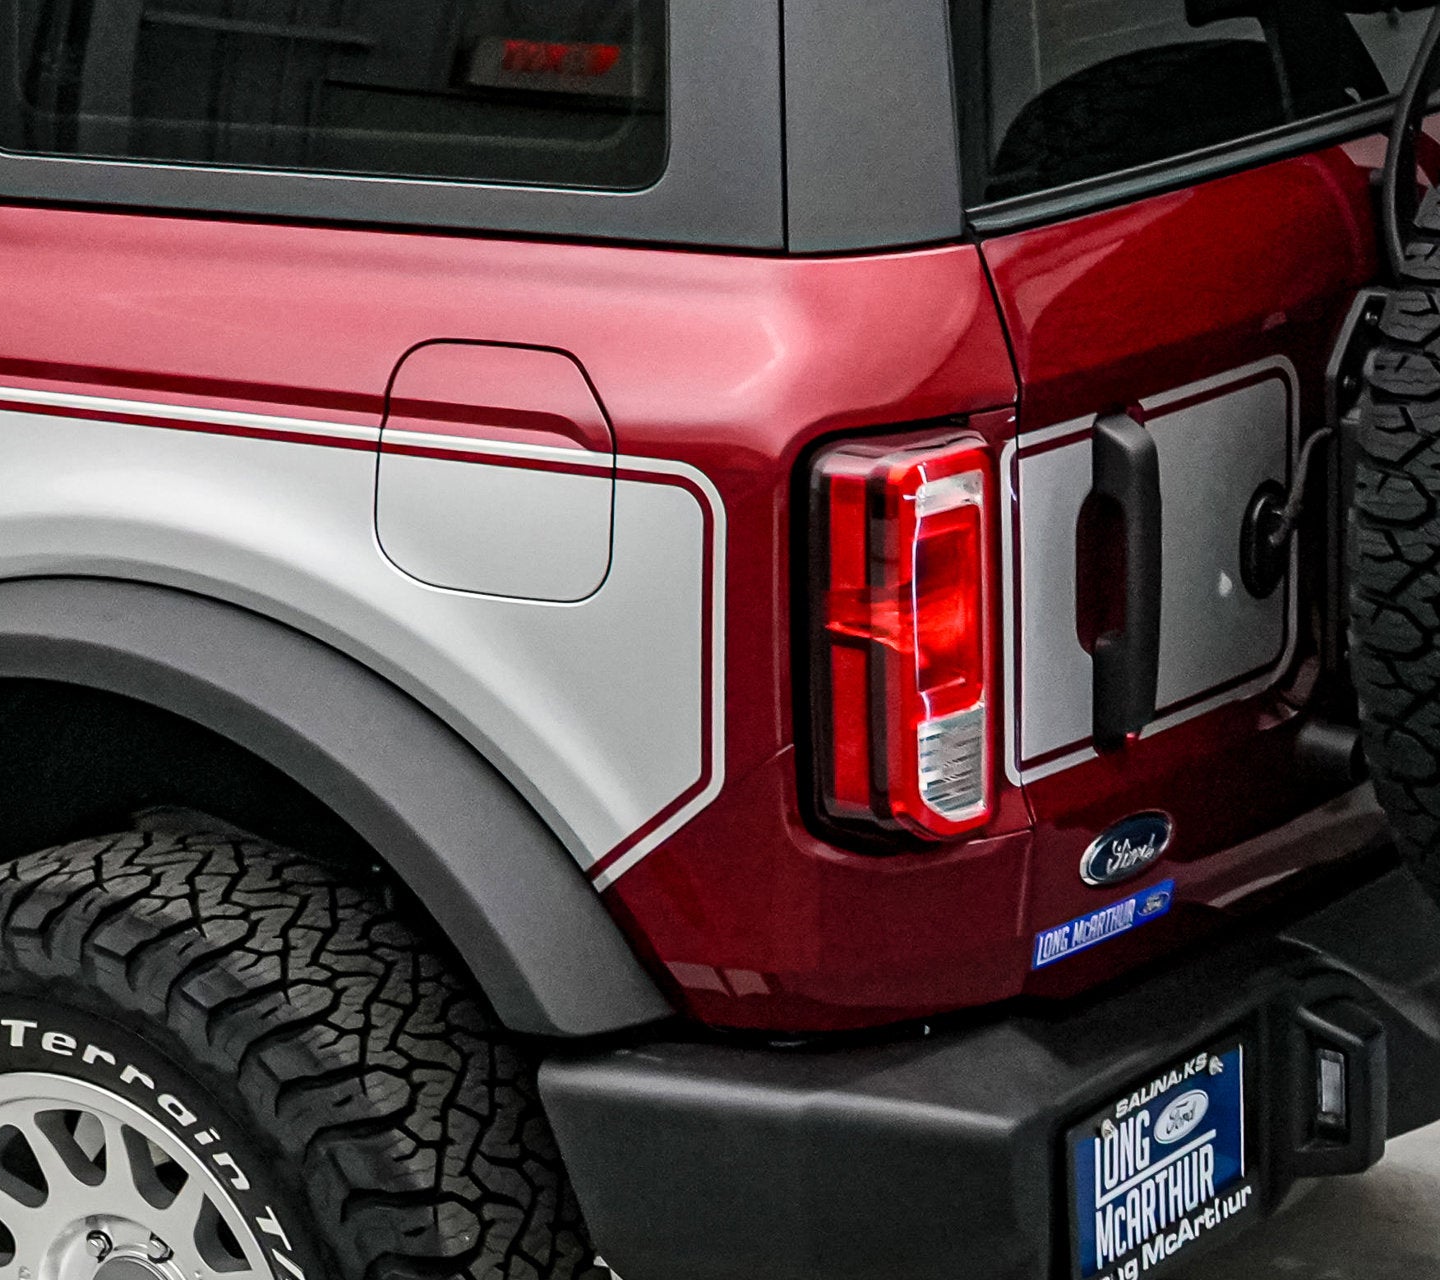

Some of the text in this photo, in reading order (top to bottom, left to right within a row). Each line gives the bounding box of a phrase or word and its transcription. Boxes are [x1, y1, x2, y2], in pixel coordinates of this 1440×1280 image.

[1106, 832, 1156, 874] Ford
[1036, 925, 1071, 966] LONG
[1094, 1109, 1151, 1209] LONG
[1141, 1185, 1252, 1271] McArthur
